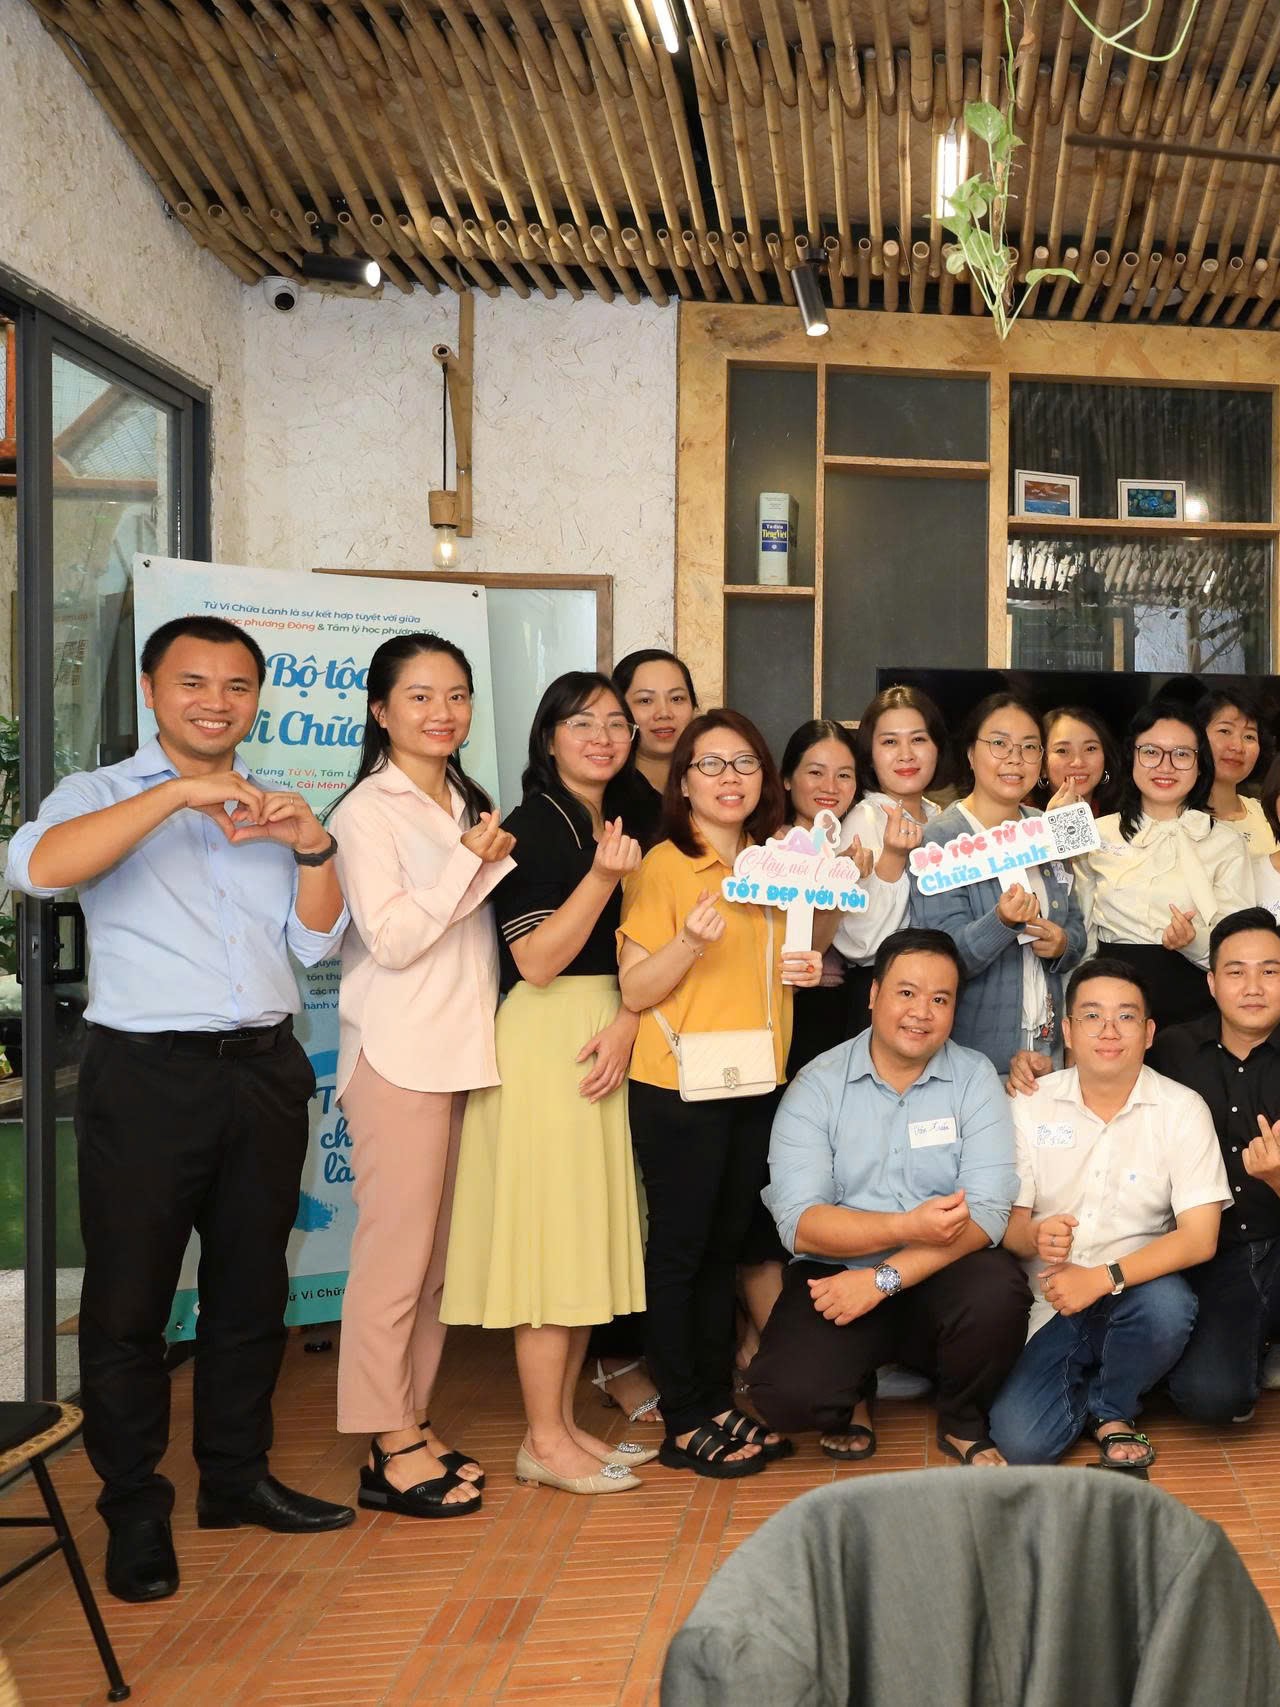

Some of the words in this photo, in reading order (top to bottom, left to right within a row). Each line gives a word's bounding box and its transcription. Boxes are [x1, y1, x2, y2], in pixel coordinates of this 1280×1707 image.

[317, 623, 325, 631] &
[266, 652, 325, 698] Bộ
[920, 866, 982, 893] Chữa
[988, 843, 1048, 874] Lành
[726, 875, 760, 899] TỐT
[766, 885, 799, 906] ĐẸP
[804, 884, 834, 906] VỚI
[840, 888, 866, 909] TÔI
